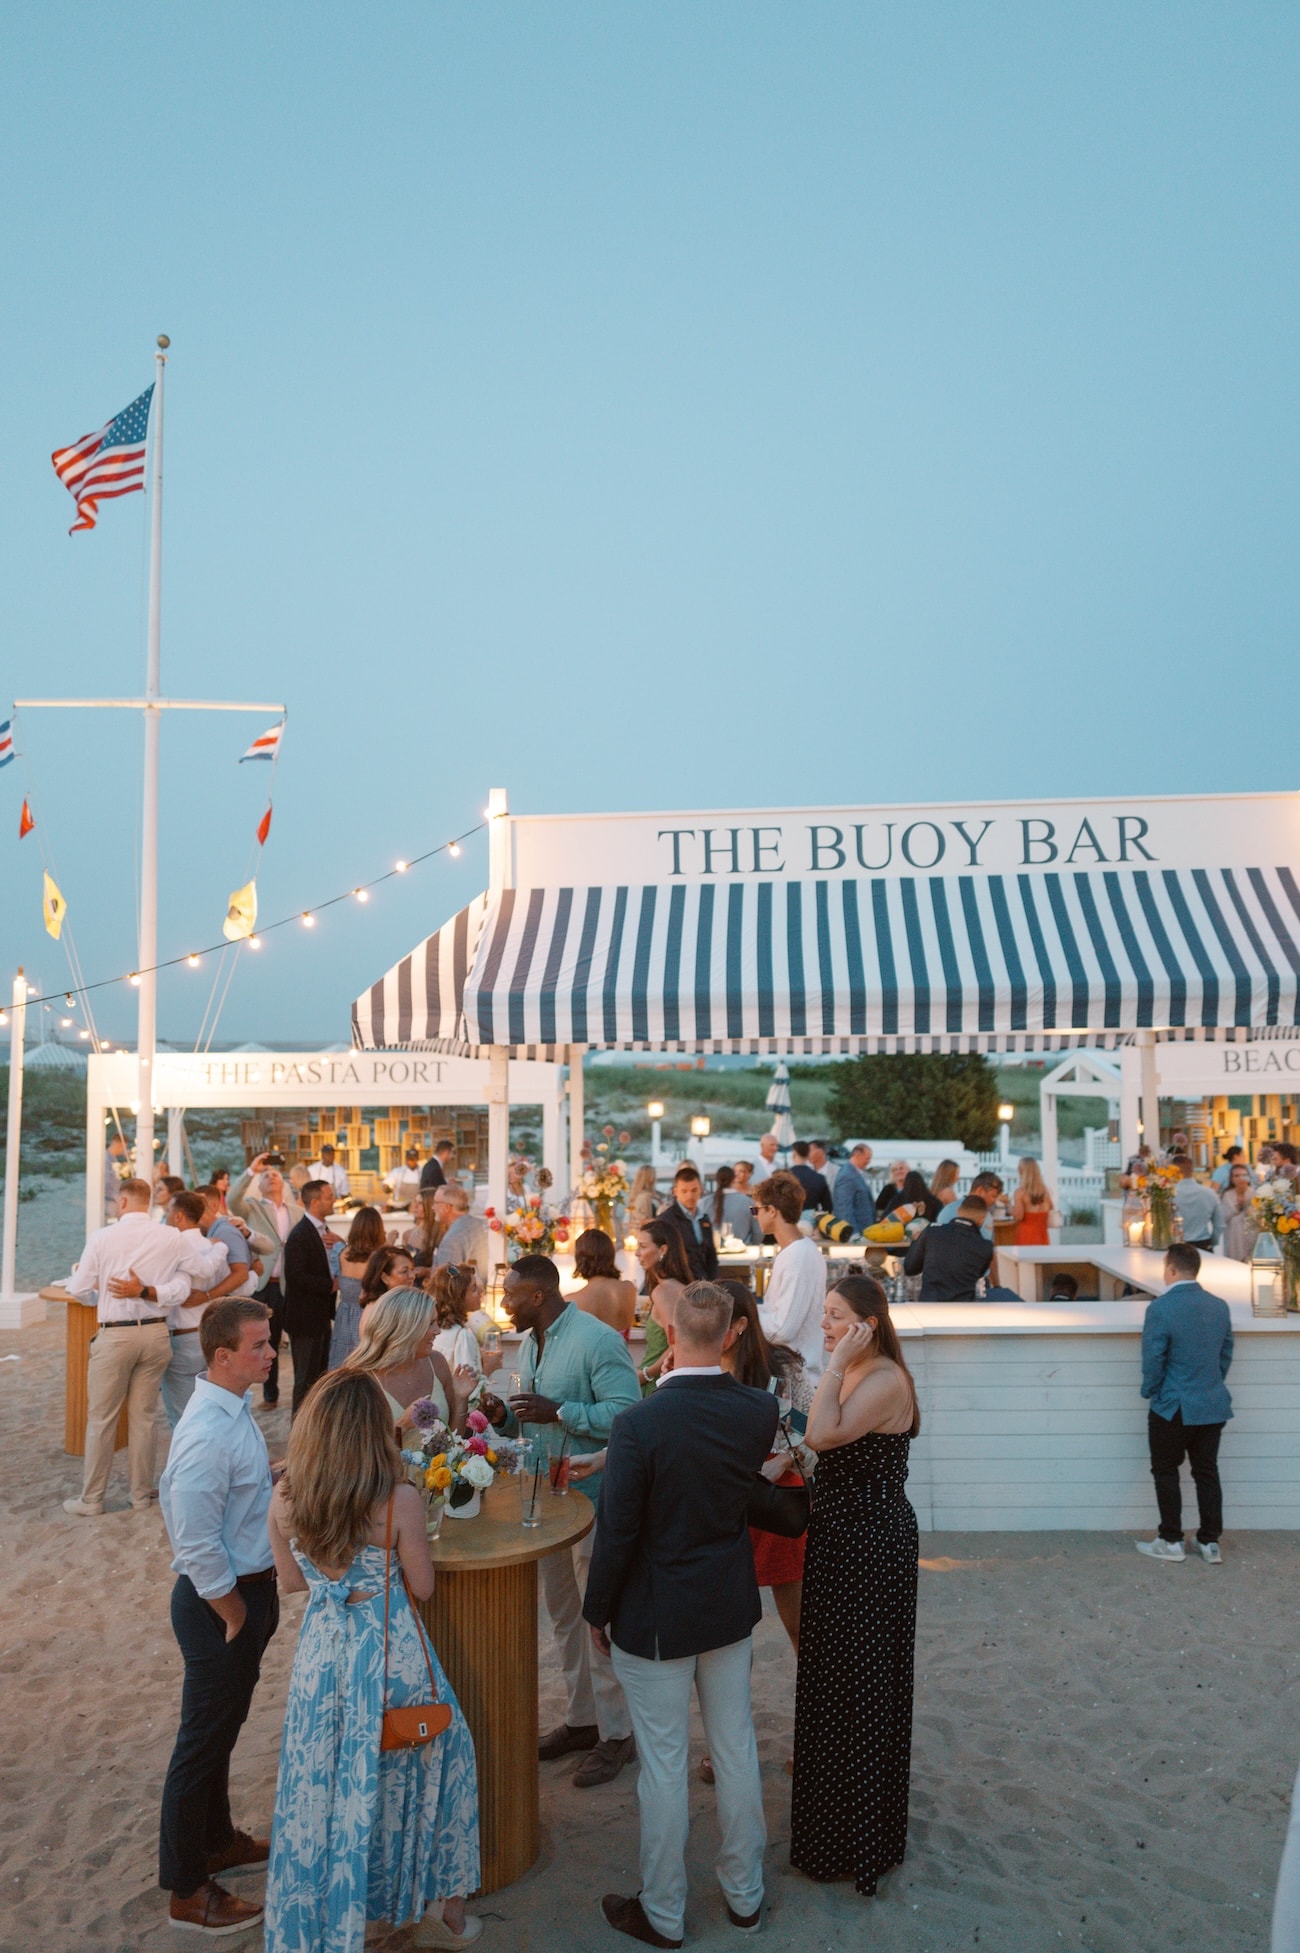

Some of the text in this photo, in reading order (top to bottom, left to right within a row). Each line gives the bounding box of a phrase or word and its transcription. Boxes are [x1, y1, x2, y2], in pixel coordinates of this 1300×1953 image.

[657, 815, 1160, 876] THE BUOY BAR
[203, 1060, 448, 1084] THE PASTA PORT
